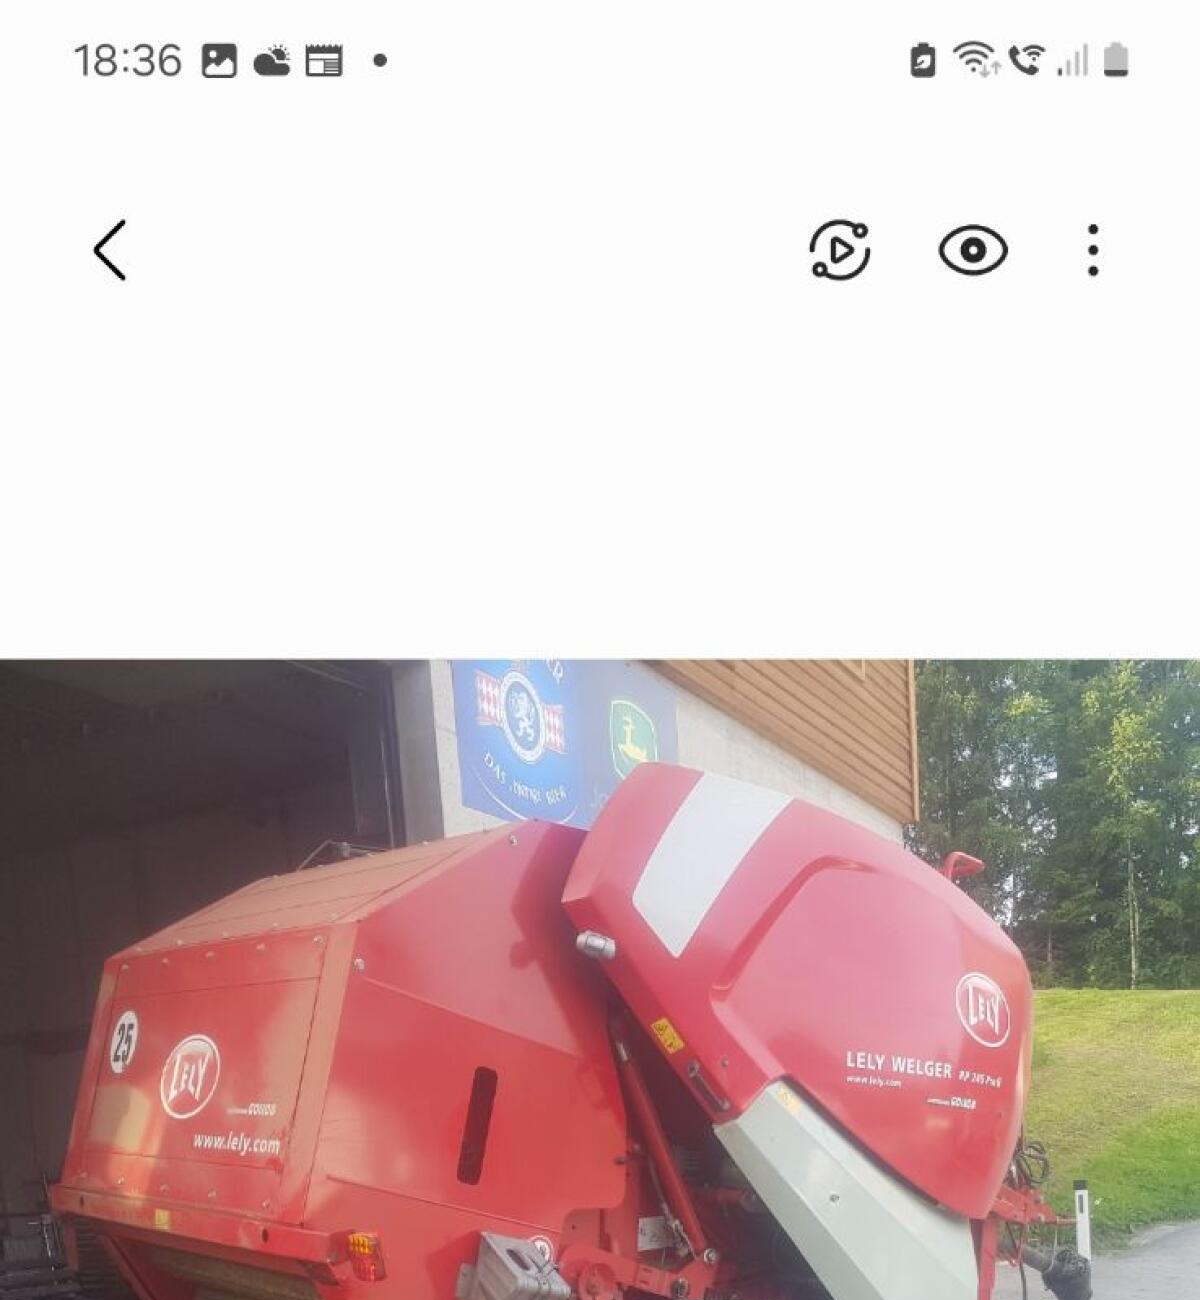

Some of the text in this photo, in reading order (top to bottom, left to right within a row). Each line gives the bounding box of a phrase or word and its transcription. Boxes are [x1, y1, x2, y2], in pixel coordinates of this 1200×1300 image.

[74, 43, 182, 77] 18:36
[967, 983, 1002, 1035] LELY
[113, 1023, 134, 1065] 25
[168, 1052, 212, 1103] LELY
[846, 1050, 886, 1072] LELY
[891, 1056, 952, 1079] WELGER
[846, 1075, 902, 1089] www.lely.com
[193, 1131, 281, 1156] www.lely.com
